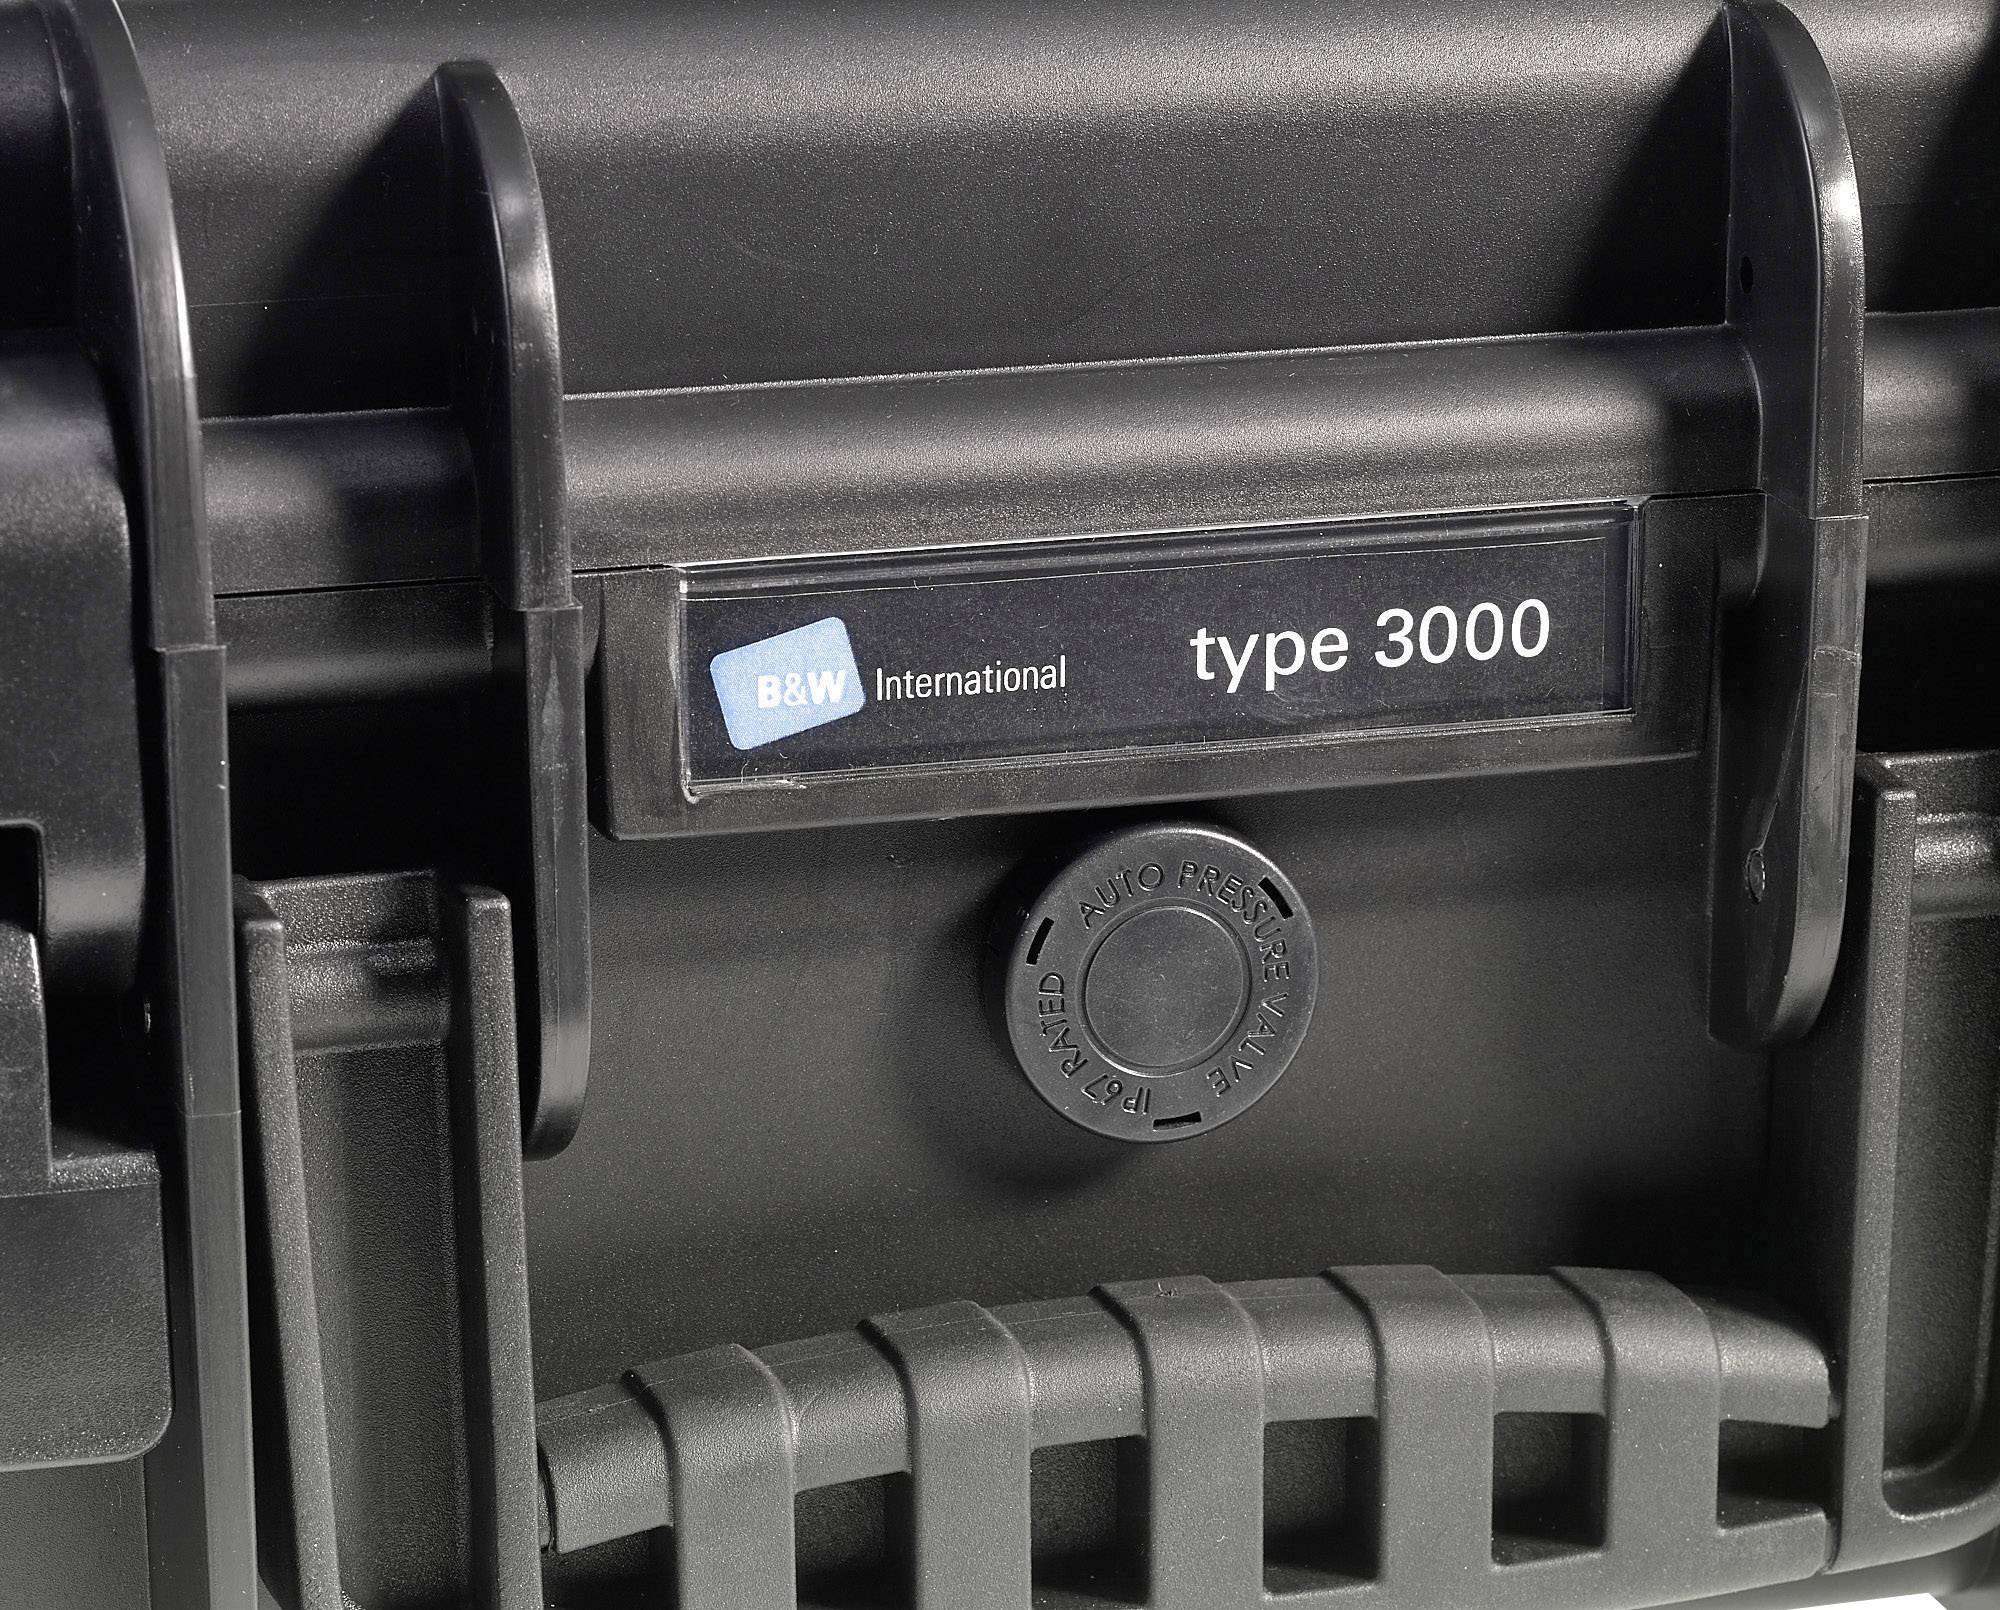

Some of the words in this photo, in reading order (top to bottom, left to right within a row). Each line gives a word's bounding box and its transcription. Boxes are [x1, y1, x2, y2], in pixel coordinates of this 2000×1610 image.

[757, 669, 847, 709] B&W
[875, 655, 1067, 702] International
[1190, 625, 1348, 693] type
[1374, 598, 1551, 668] 3000
[1079, 862, 1164, 929] AUTO
[1177, 860, 1290, 982] PRESSURE
[1038, 971, 1088, 1079] RATED
[1206, 992, 1289, 1097] VALVE
[1081, 1073, 1151, 1115] IP67
